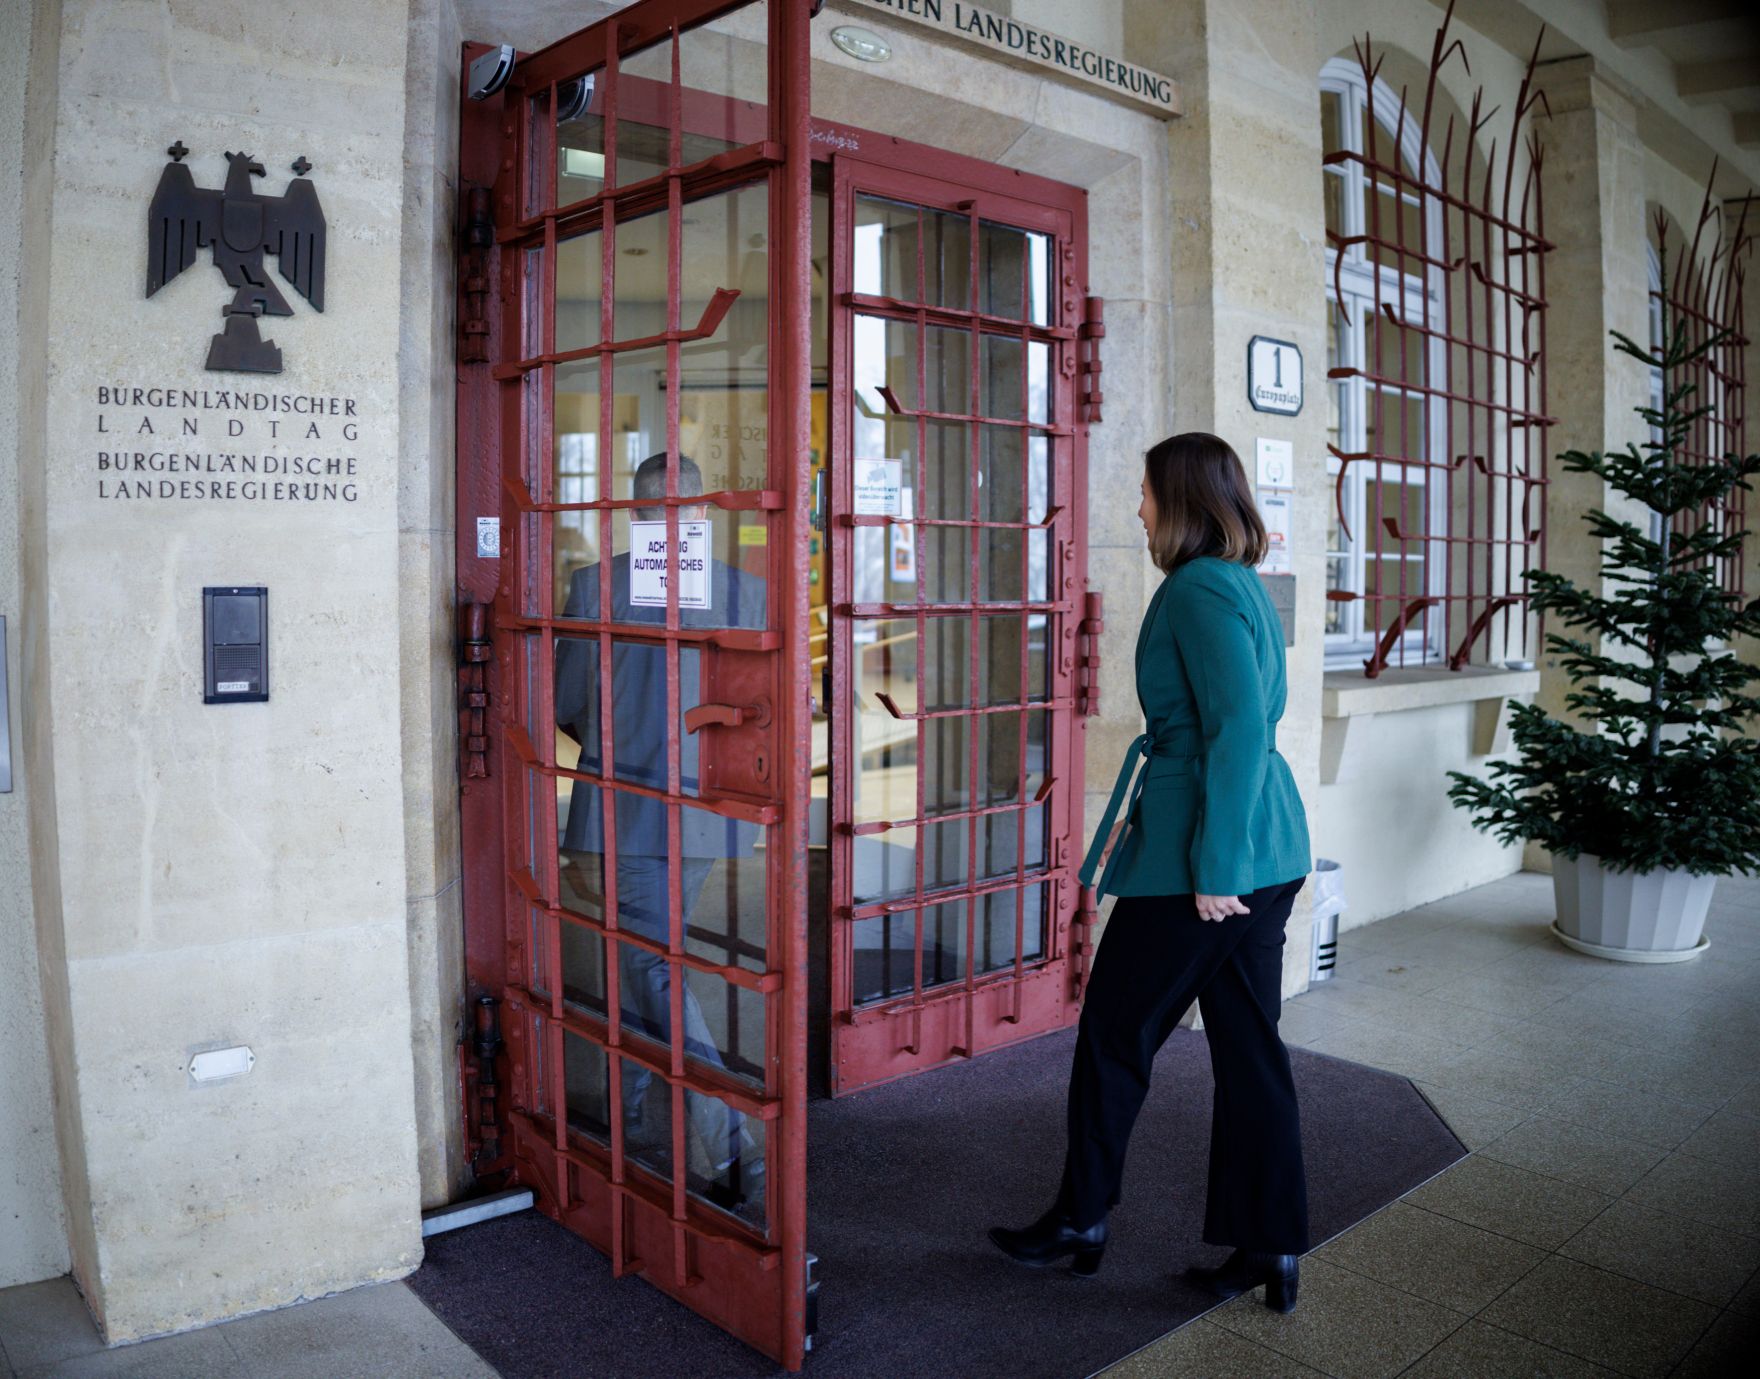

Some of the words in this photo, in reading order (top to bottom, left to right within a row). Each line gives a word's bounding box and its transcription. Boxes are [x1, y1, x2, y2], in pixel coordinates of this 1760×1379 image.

[955, 9, 1171, 103] LANDESREGIERUNG
[1273, 347, 1283, 388] 1
[98, 386, 357, 416] BURGENLÄNDISCHER
[98, 452, 357, 475] BURGENLÄNDISCHE
[98, 480, 358, 501] LANDESREGIERUNG
[648, 541, 688, 553] ACHG
[634, 559, 703, 571] AUTOMACHES
